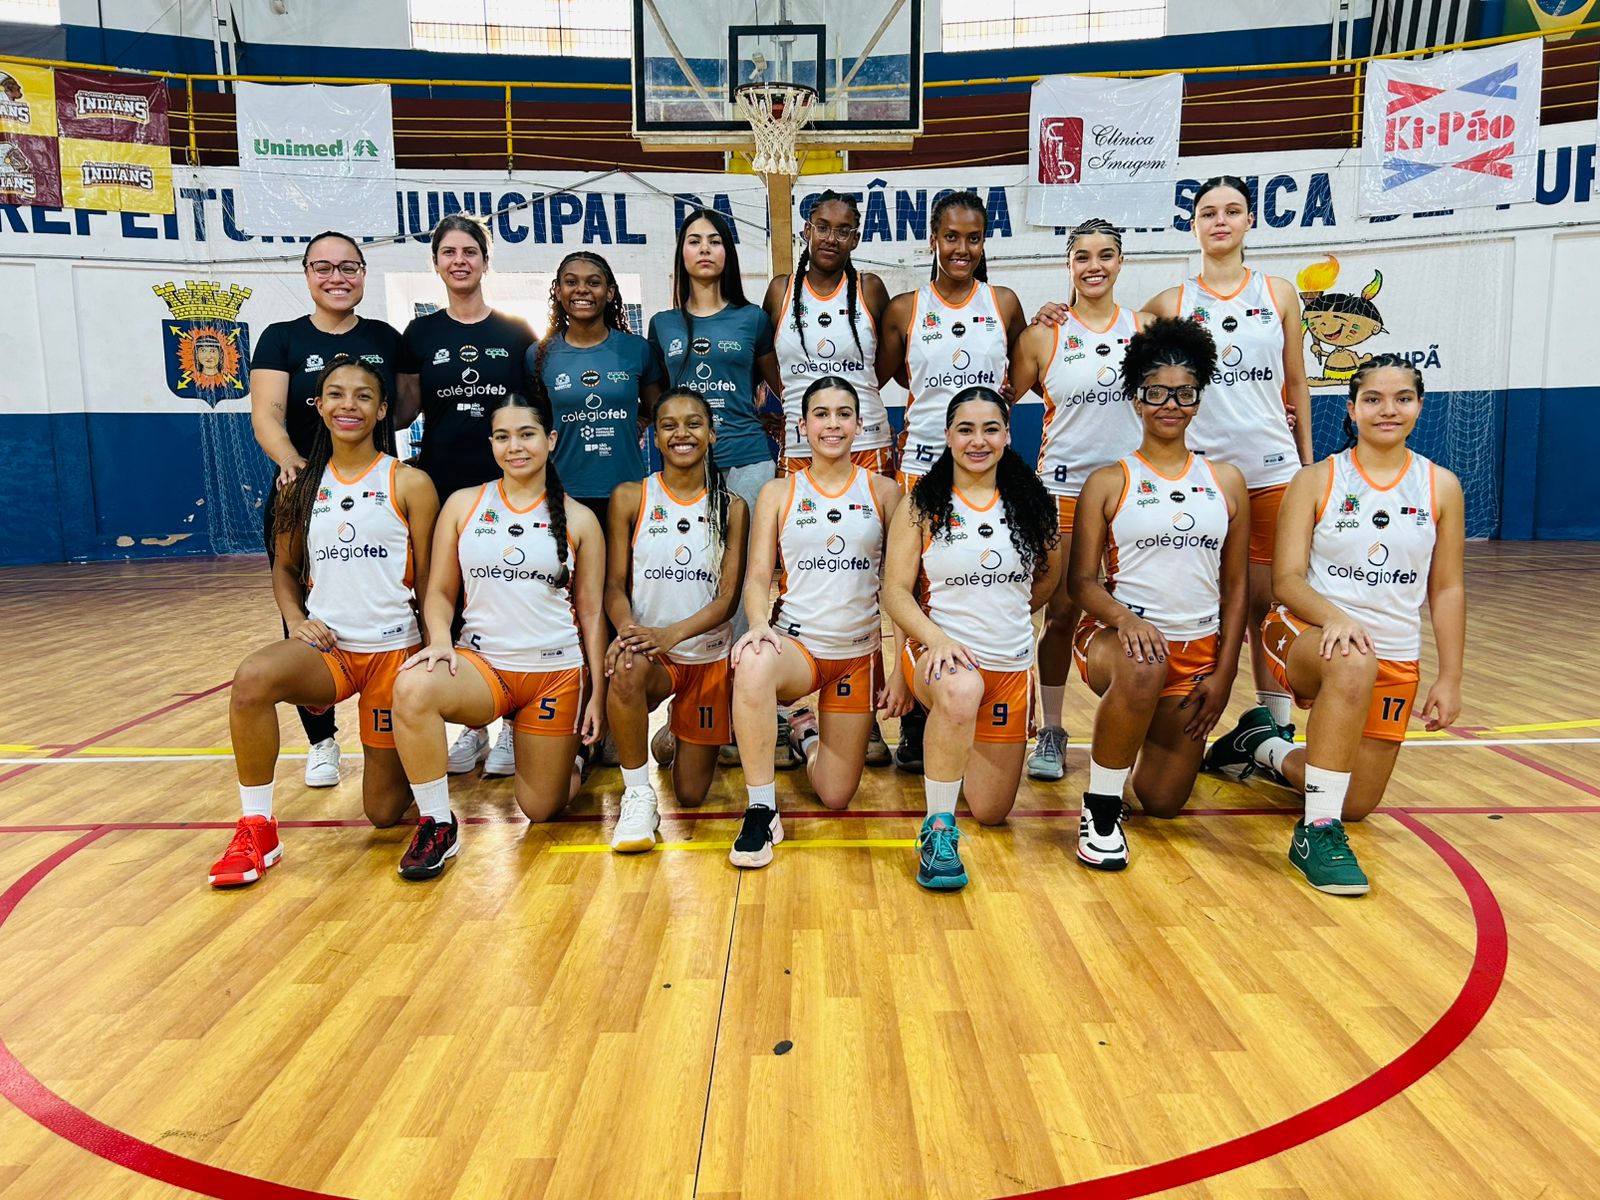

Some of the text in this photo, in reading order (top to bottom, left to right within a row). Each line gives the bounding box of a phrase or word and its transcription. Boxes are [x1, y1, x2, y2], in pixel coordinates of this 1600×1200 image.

[78, 96, 147, 120] INDIANS
[1092, 124, 1155, 146] Clínica
[254, 138, 344, 157] Unimed
[1088, 150, 1167, 177] Imagem
[83, 166, 152, 190] INDIANS
[791, 359, 864, 375] colégiofeb
[437, 383, 506, 397] colégiofeb
[561, 409, 628, 422] colégiofeb
[916, 443, 934, 462] 15
[1054, 464, 1066, 482] 8
[796, 516, 817, 528] apab
[1136, 533, 1219, 550] colégiofeb
[470, 565, 555, 584] colégiofeb
[798, 556, 870, 573] colégiofeb
[945, 571, 1030, 587] colégiofeb
[1328, 565, 1417, 586] colégiofeb
[837, 674, 851, 697] 6
[538, 697, 557, 720] 5
[698, 707, 713, 729] 11
[992, 703, 1008, 726] 9
[1382, 697, 1406, 721] 17
[372, 709, 392, 732] 13
